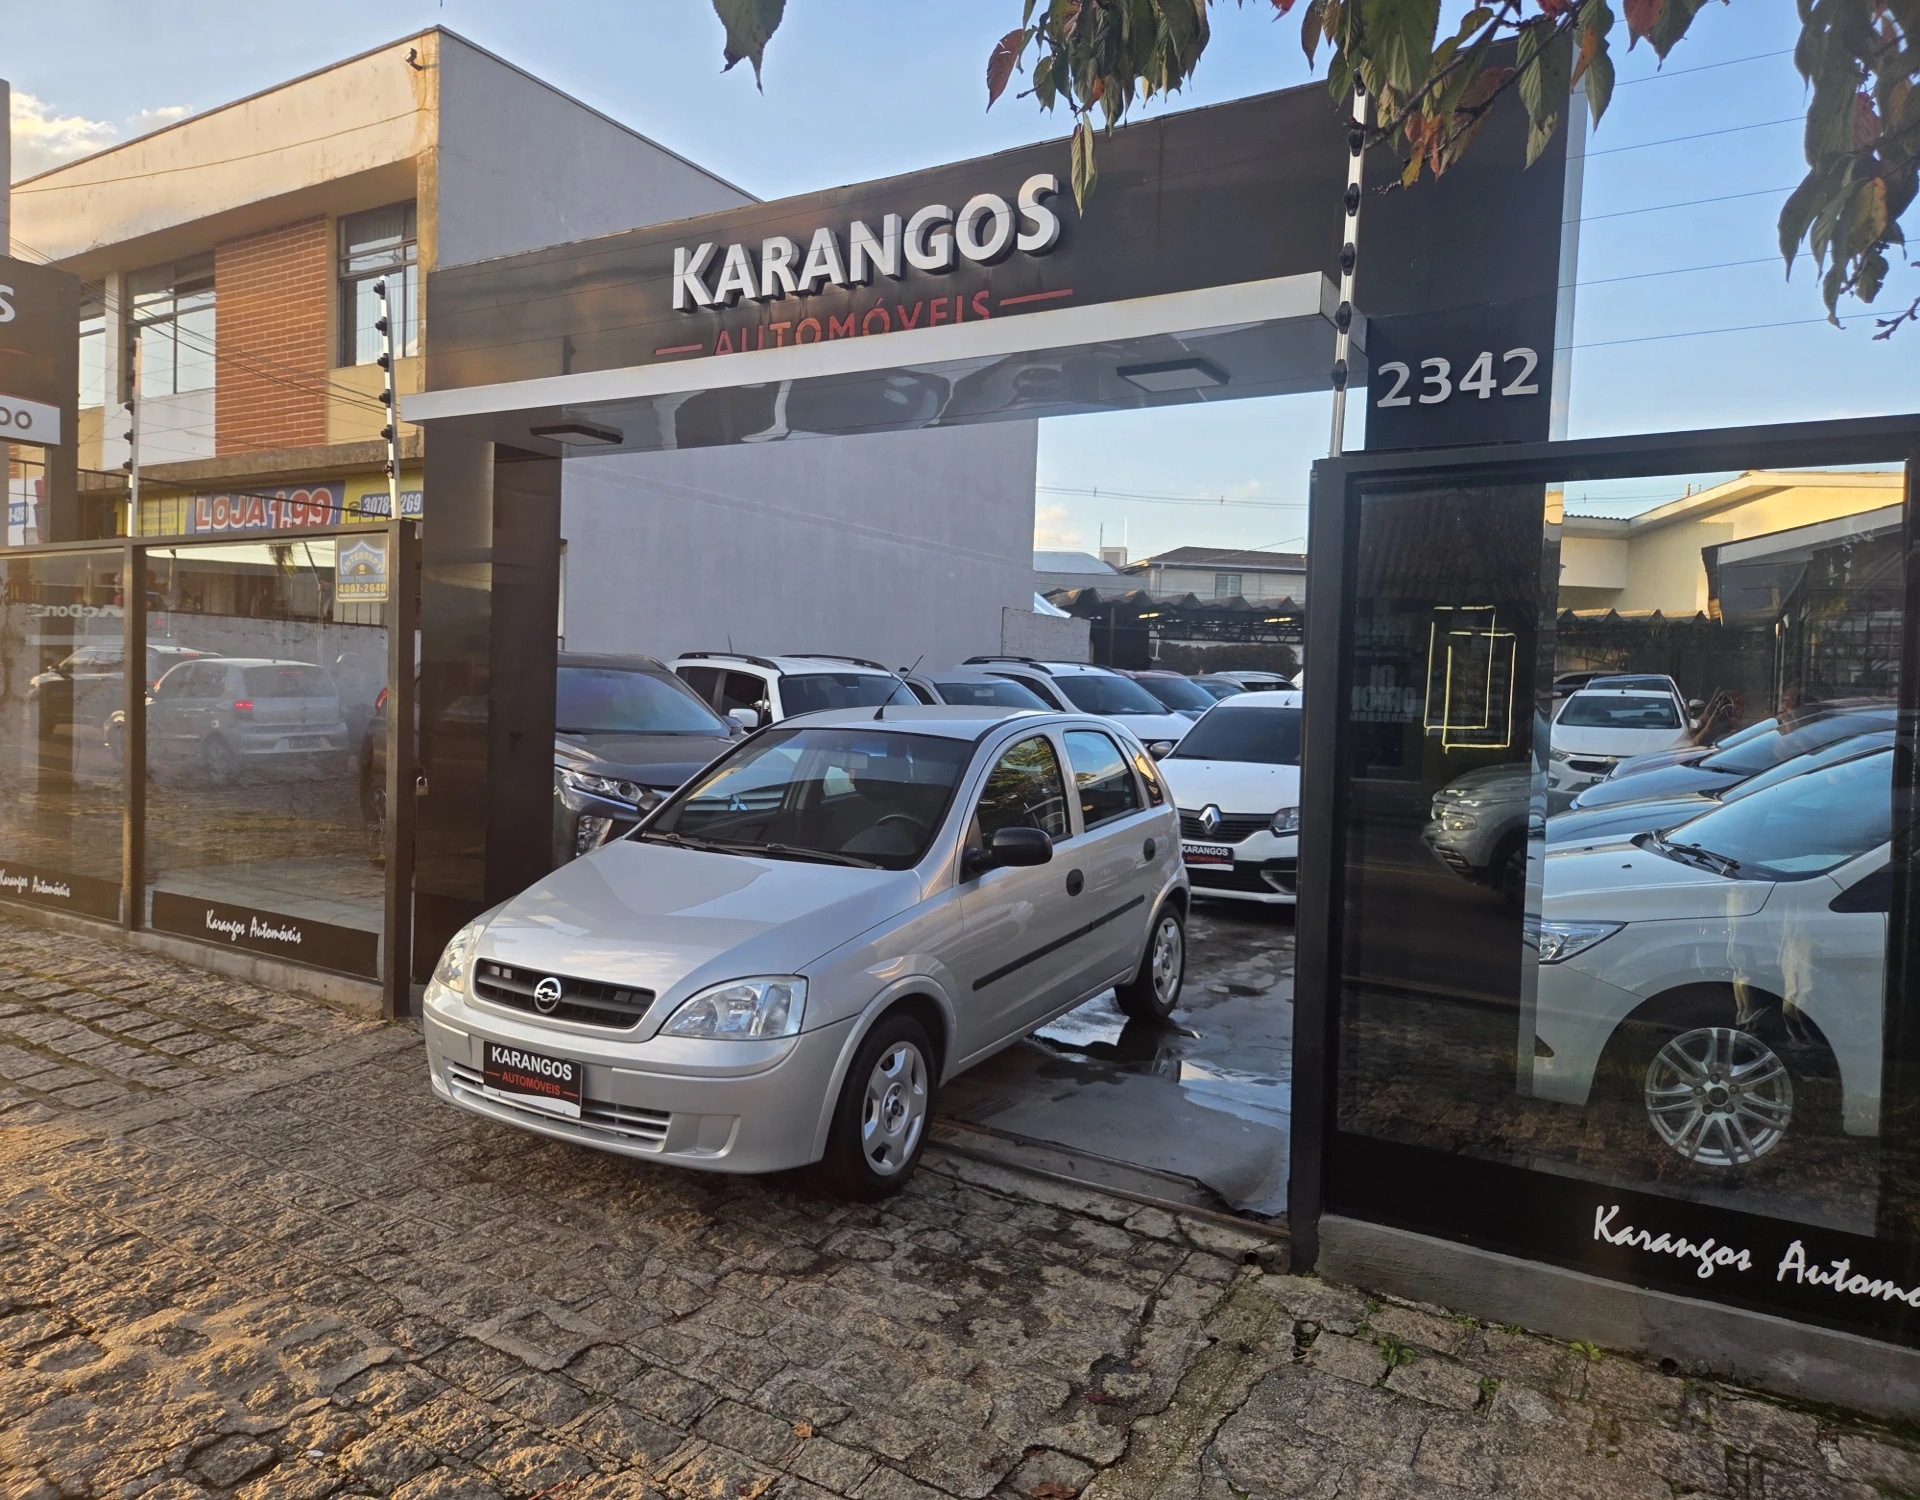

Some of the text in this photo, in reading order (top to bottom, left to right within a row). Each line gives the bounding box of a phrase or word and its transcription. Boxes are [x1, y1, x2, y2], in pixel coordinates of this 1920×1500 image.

[672, 173, 1060, 312] KARANGOS
[1377, 347, 1539, 408] 2342
[195, 495, 267, 530] LOJA
[363, 493, 422, 516] 3078-269
[343, 551, 383, 572] INTERSEPT
[339, 583, 387, 593] 4007-2640
[1182, 845, 1229, 857] KARANGOS
[205, 909, 302, 944] Karangos Automóveis
[491, 1046, 573, 1081] KARANGOS
[502, 1071, 561, 1097] AUTOMÓVEIS
[1593, 1205, 1752, 1279] Karangos
